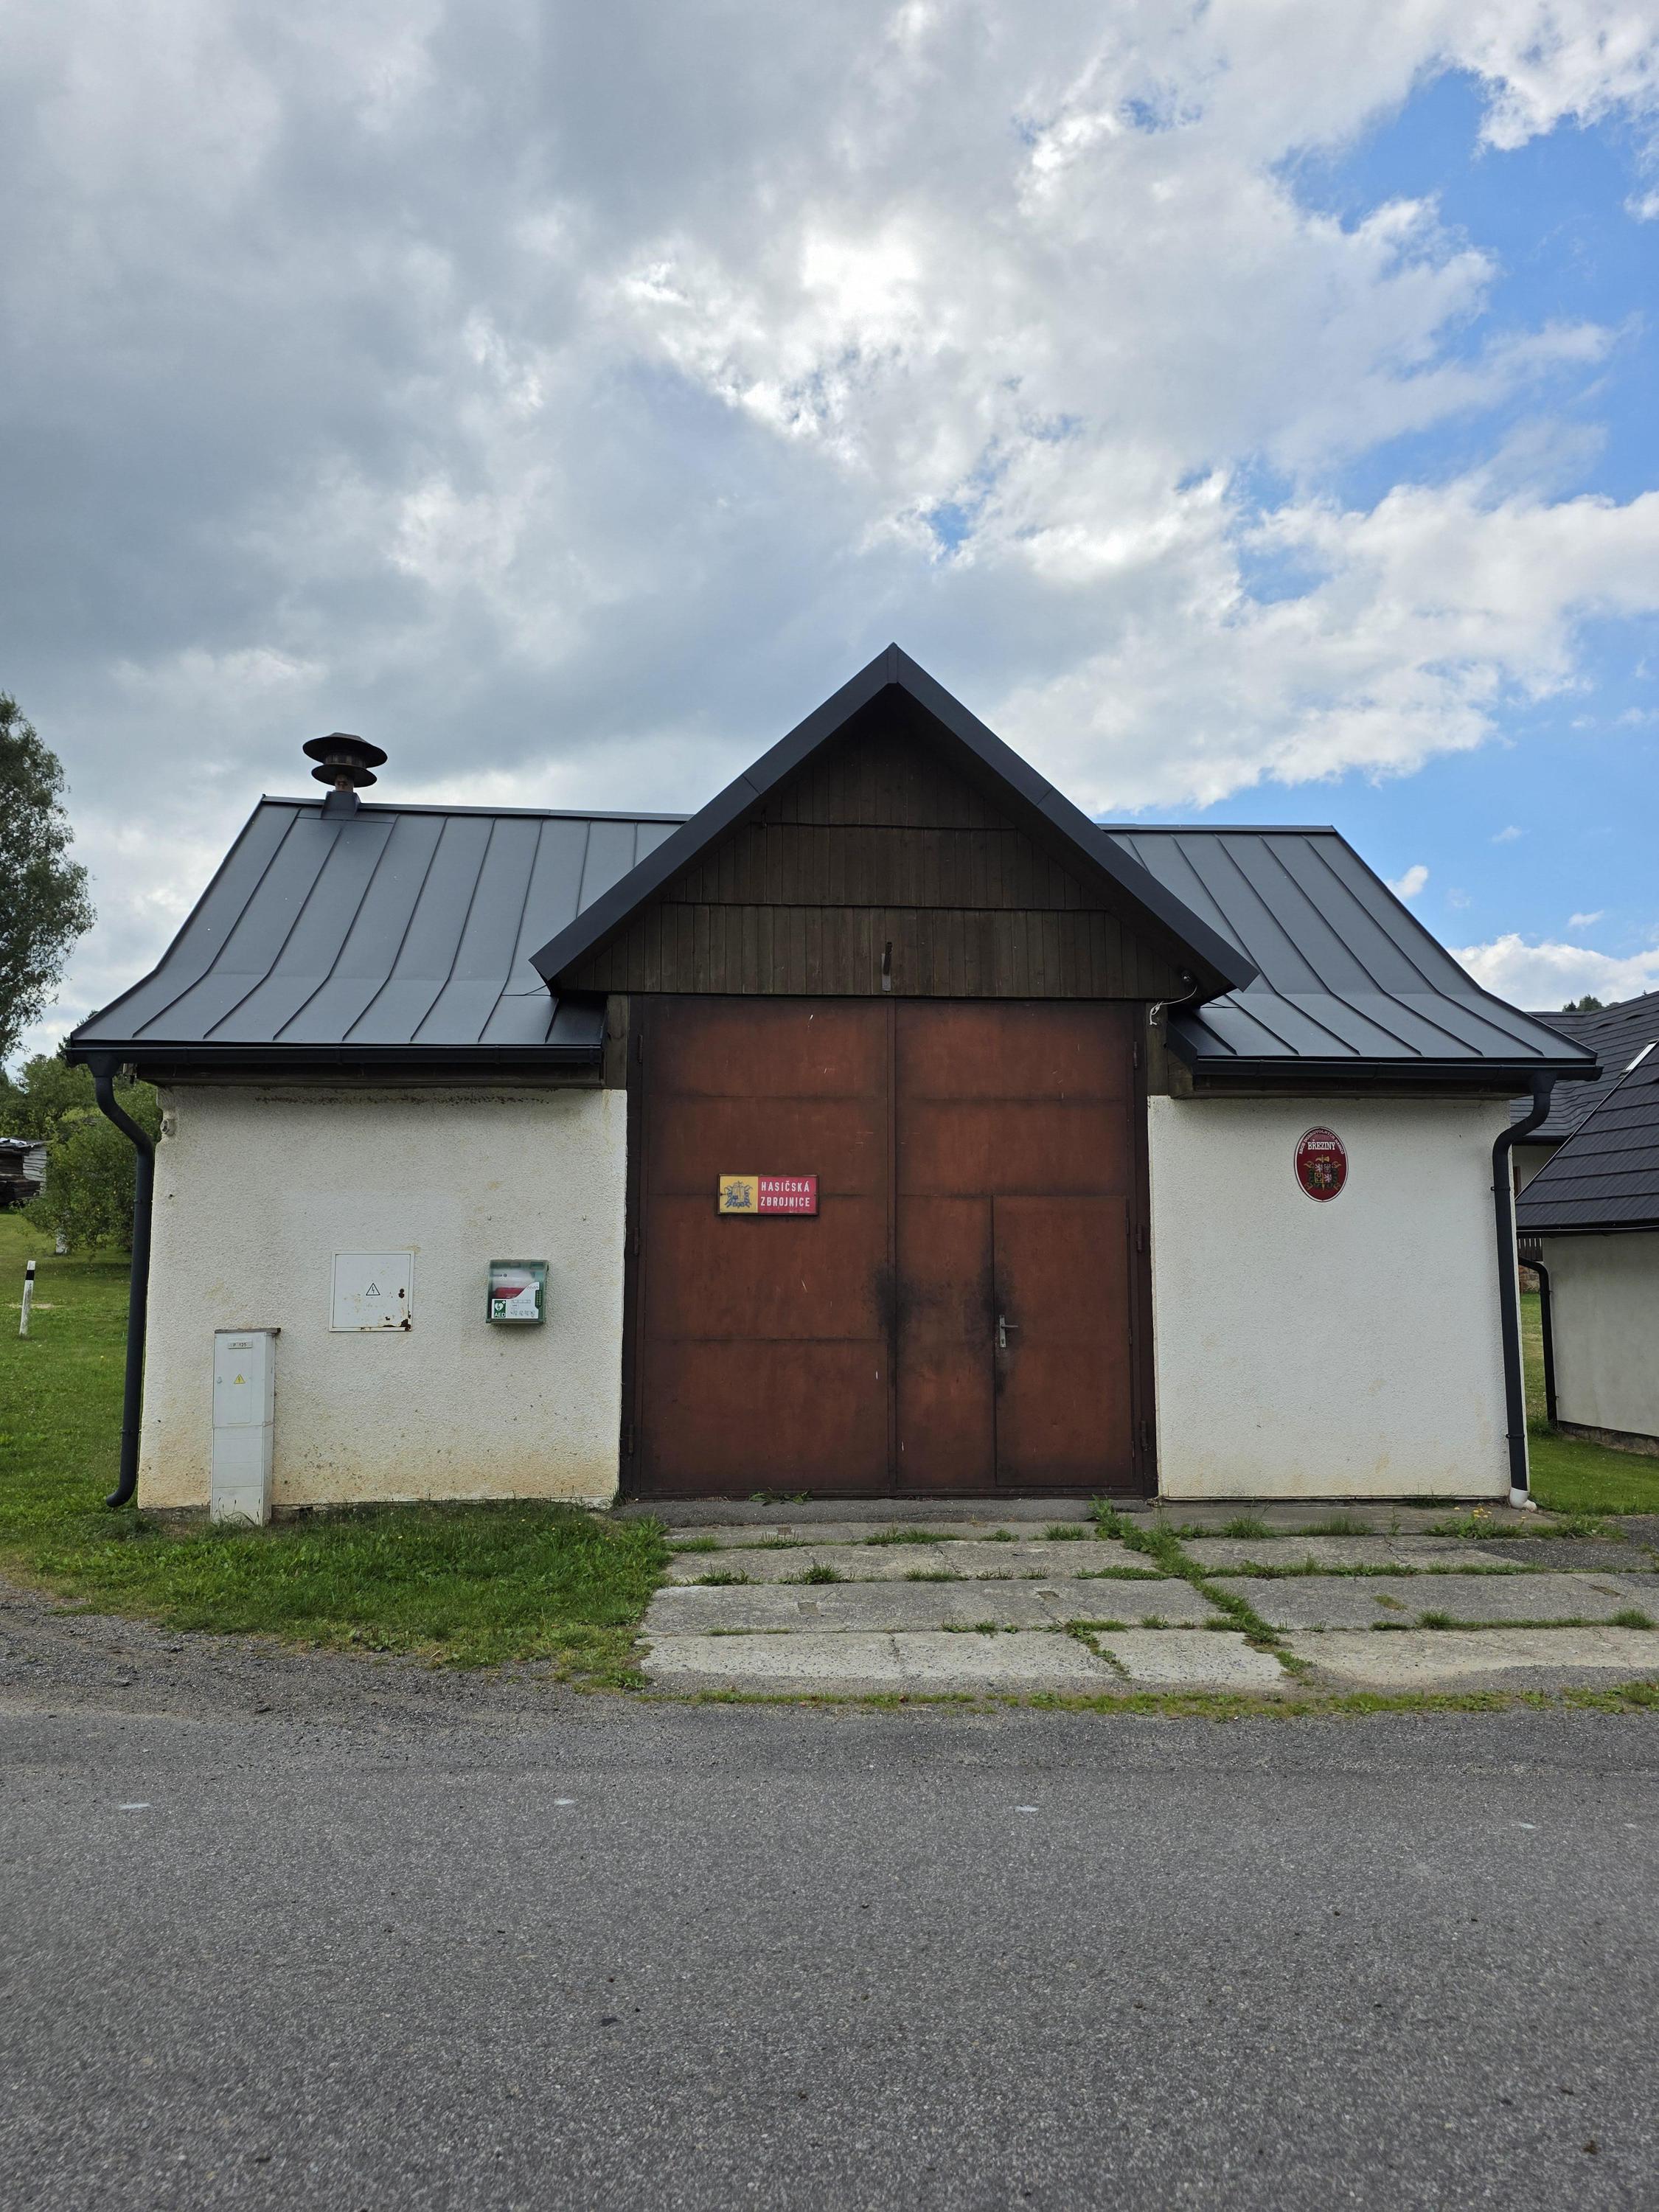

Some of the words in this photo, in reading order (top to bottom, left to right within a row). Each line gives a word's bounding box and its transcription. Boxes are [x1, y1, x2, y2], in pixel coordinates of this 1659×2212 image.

[1307, 1139, 1335, 1150] BŘEZINY
[761, 1180, 810, 1192] HASIČSKÁ
[760, 1197, 810, 1207] ZBROJNICE
